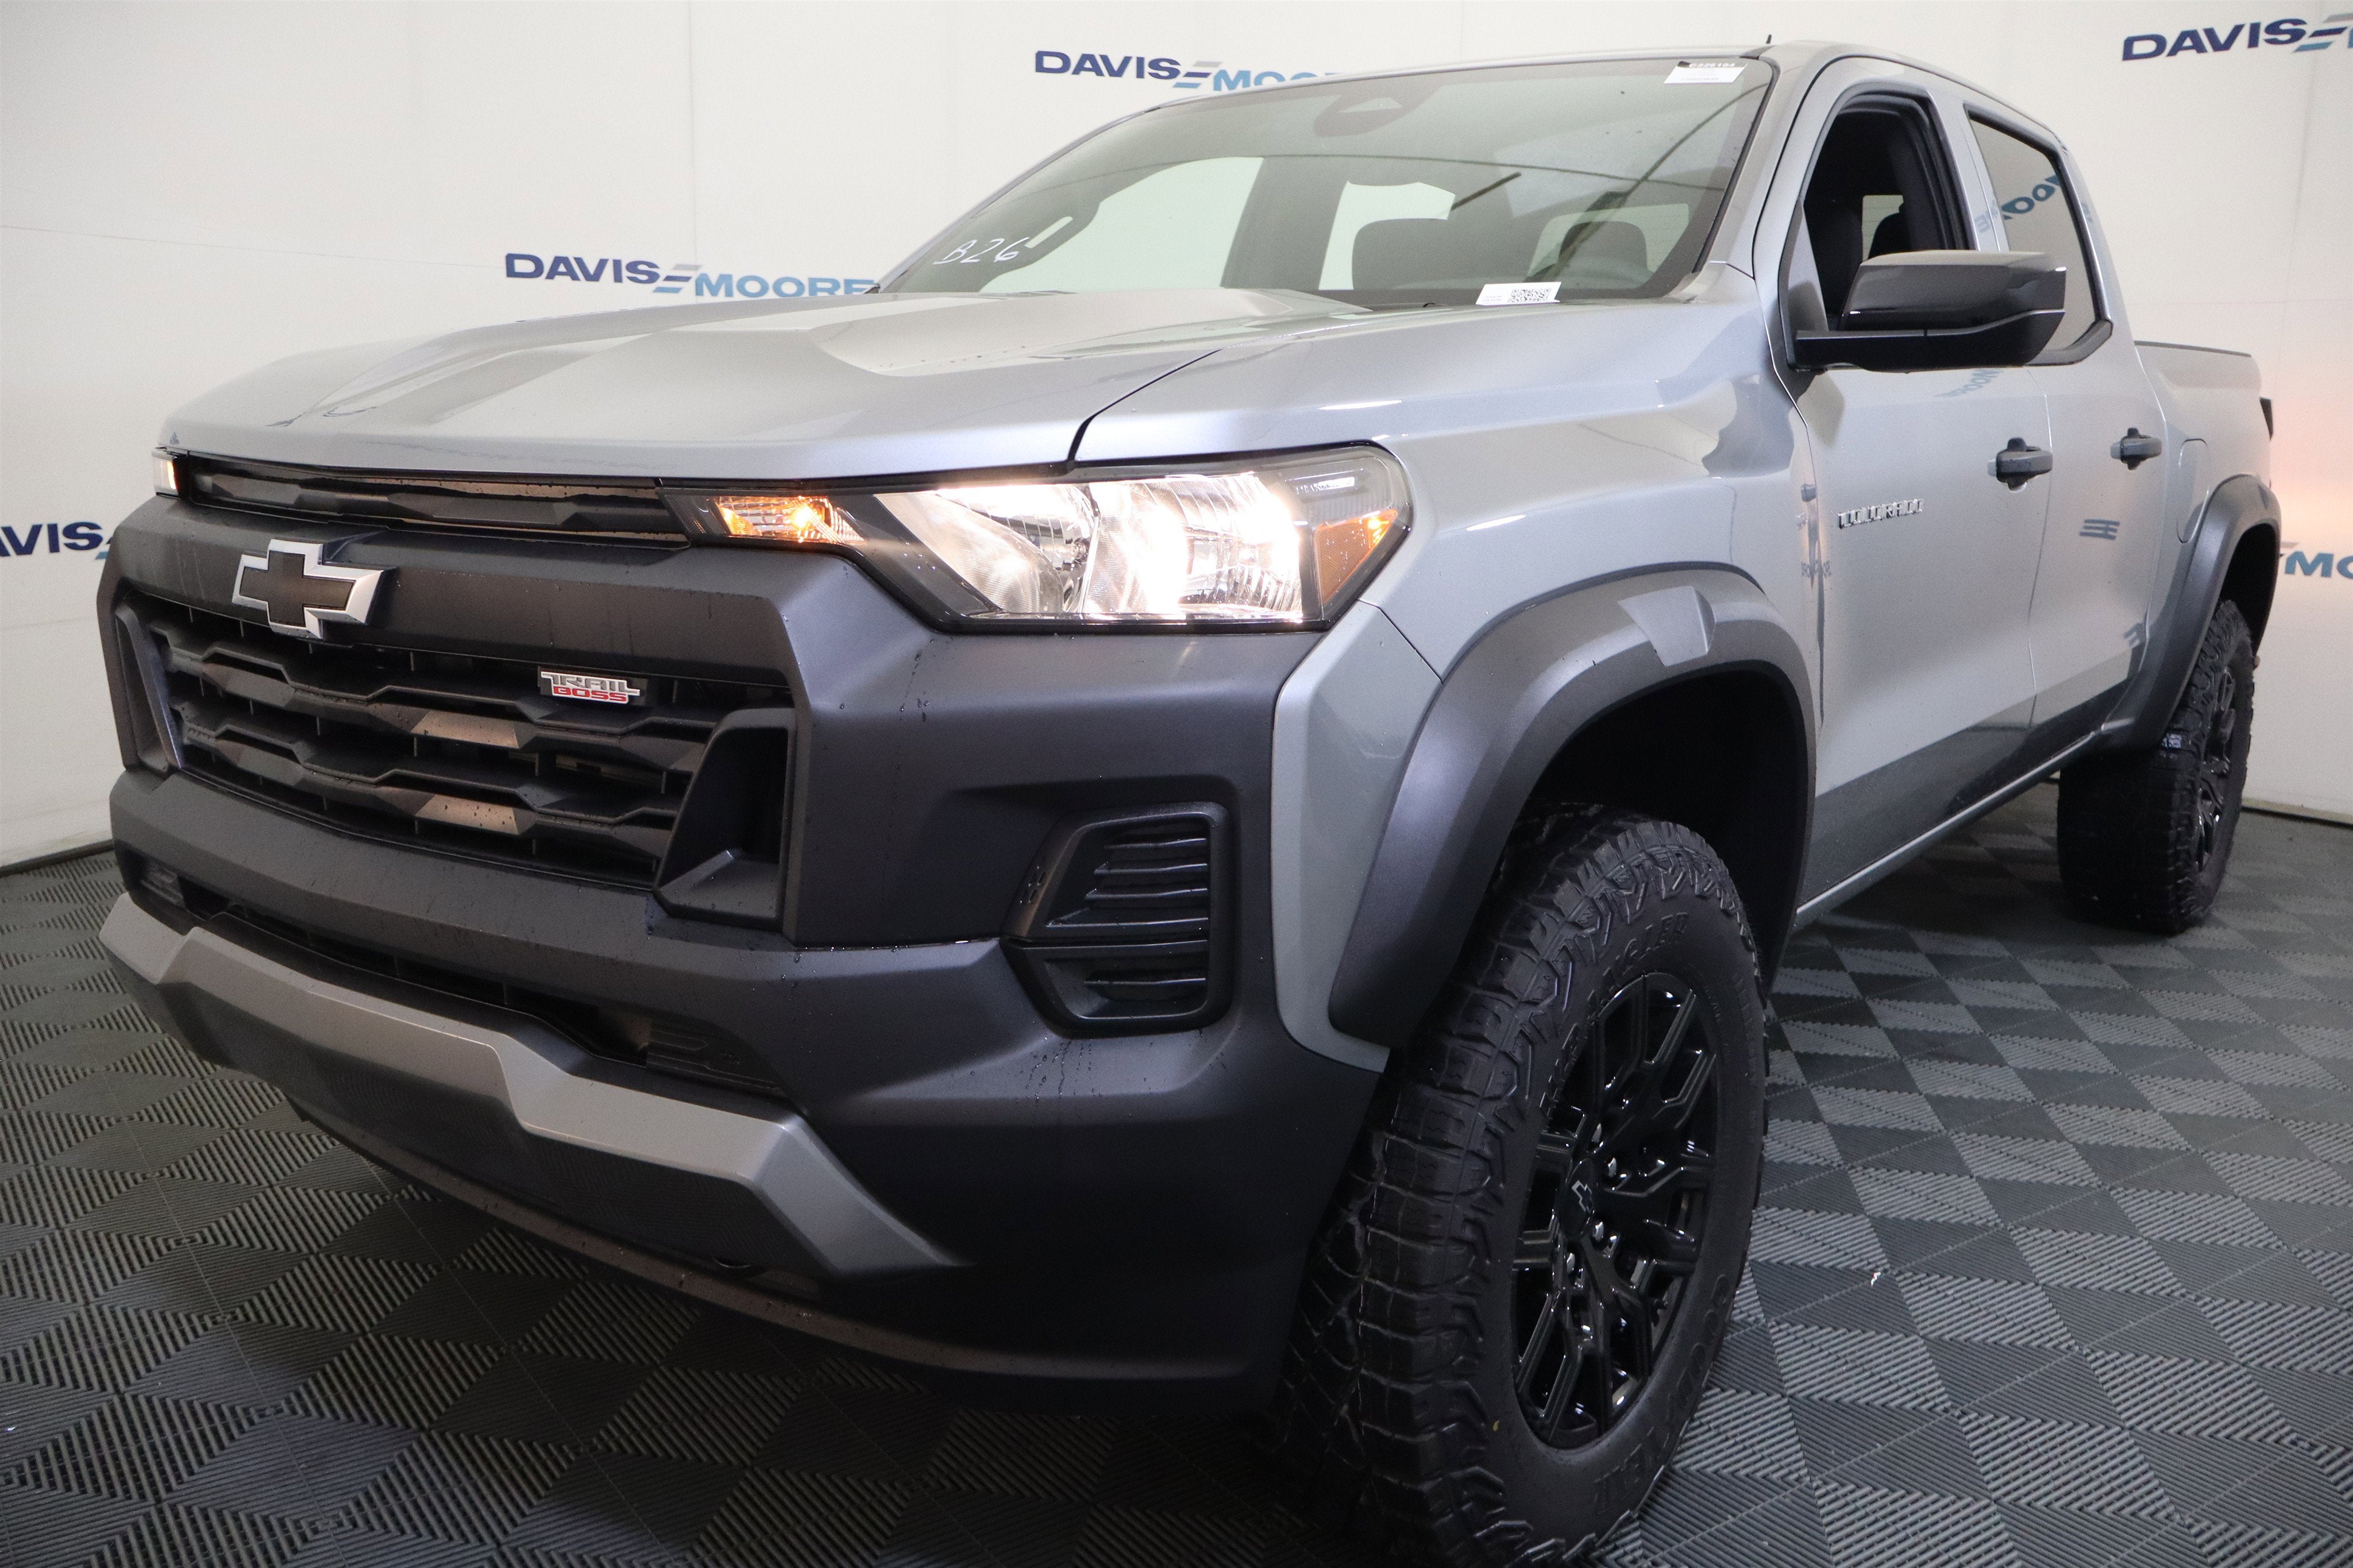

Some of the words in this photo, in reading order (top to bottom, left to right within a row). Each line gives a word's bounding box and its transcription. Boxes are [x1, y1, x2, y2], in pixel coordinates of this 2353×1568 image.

[2122, 18, 2308, 61] DAVIS
[1035, 50, 1181, 80] DAVIS
[932, 236, 1030, 265] B26
[505, 253, 661, 284] DAVIS
[541, 671, 641, 697] TRAIL
[552, 685, 629, 704] BOSS
